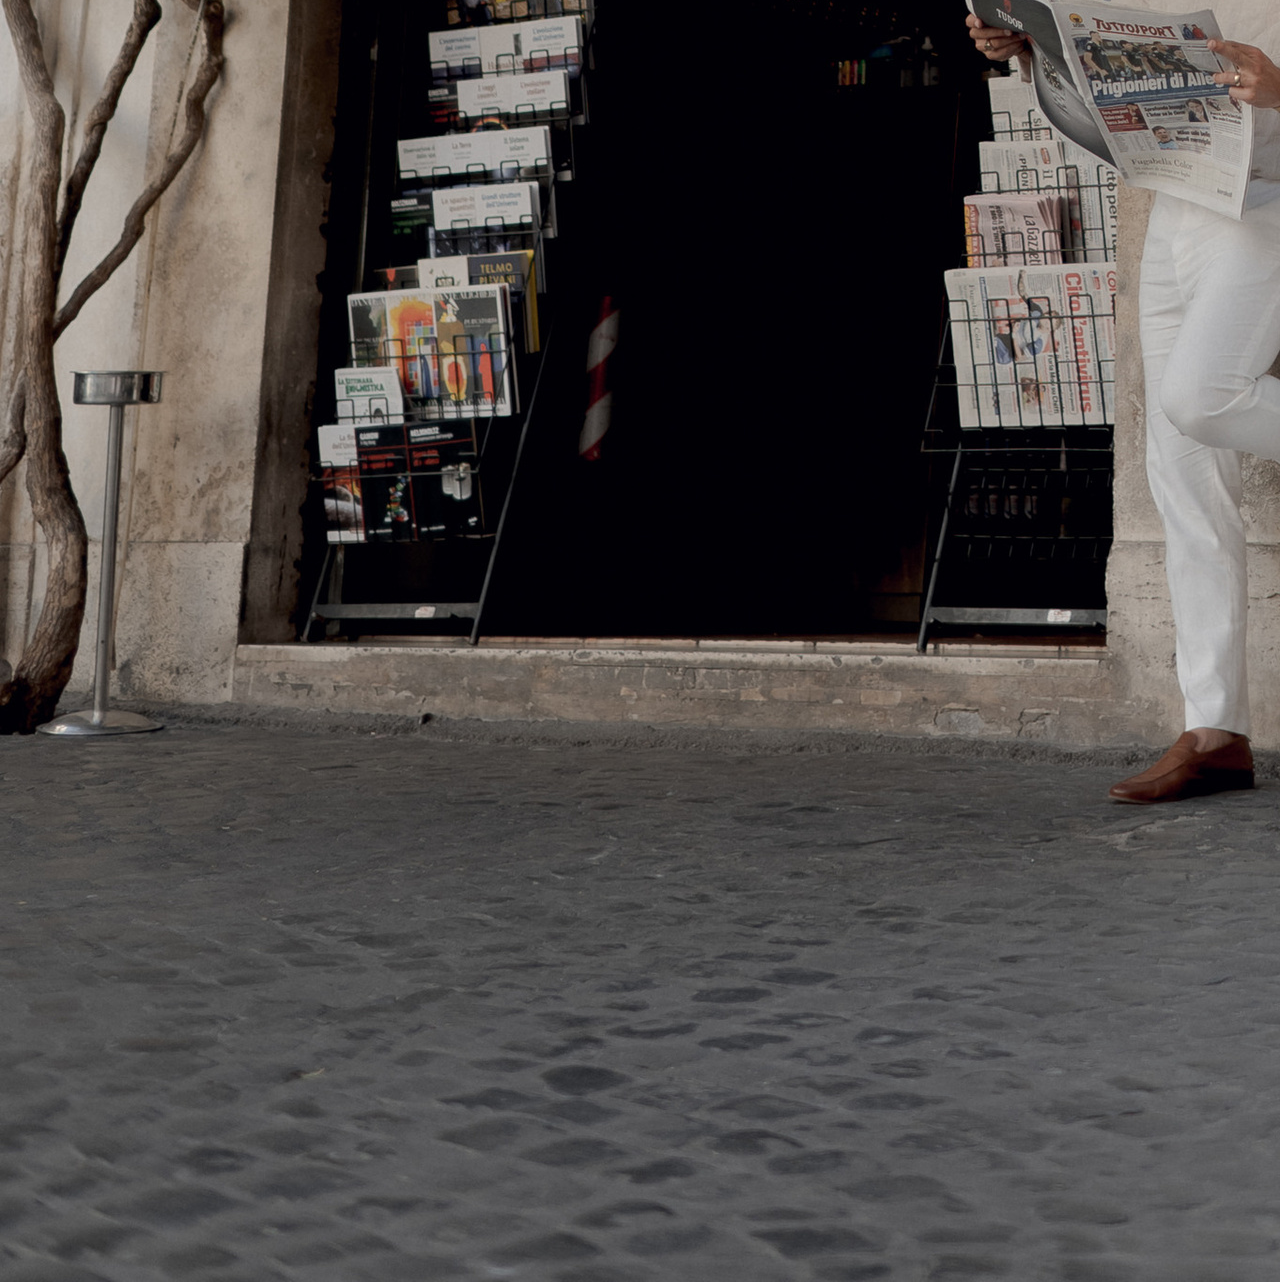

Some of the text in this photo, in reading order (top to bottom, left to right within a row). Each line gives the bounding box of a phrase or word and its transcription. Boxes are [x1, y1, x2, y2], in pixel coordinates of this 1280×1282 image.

[996, 8, 1025, 30] TUDOR
[1092, 17, 1177, 39] TUTTOSPORT
[1092, 71, 1225, 98] Prigionieri di Alle
[1173, 159, 1194, 170] Color
[1106, 167, 1117, 192] tto
[1105, 194, 1118, 221] per
[1023, 215, 1036, 226] La
[480, 262, 513, 273] TELMO
[968, 284, 979, 324] Fugabela
[1065, 272, 1082, 312] Ciro
[1071, 315, 1093, 413] l'antivirus
